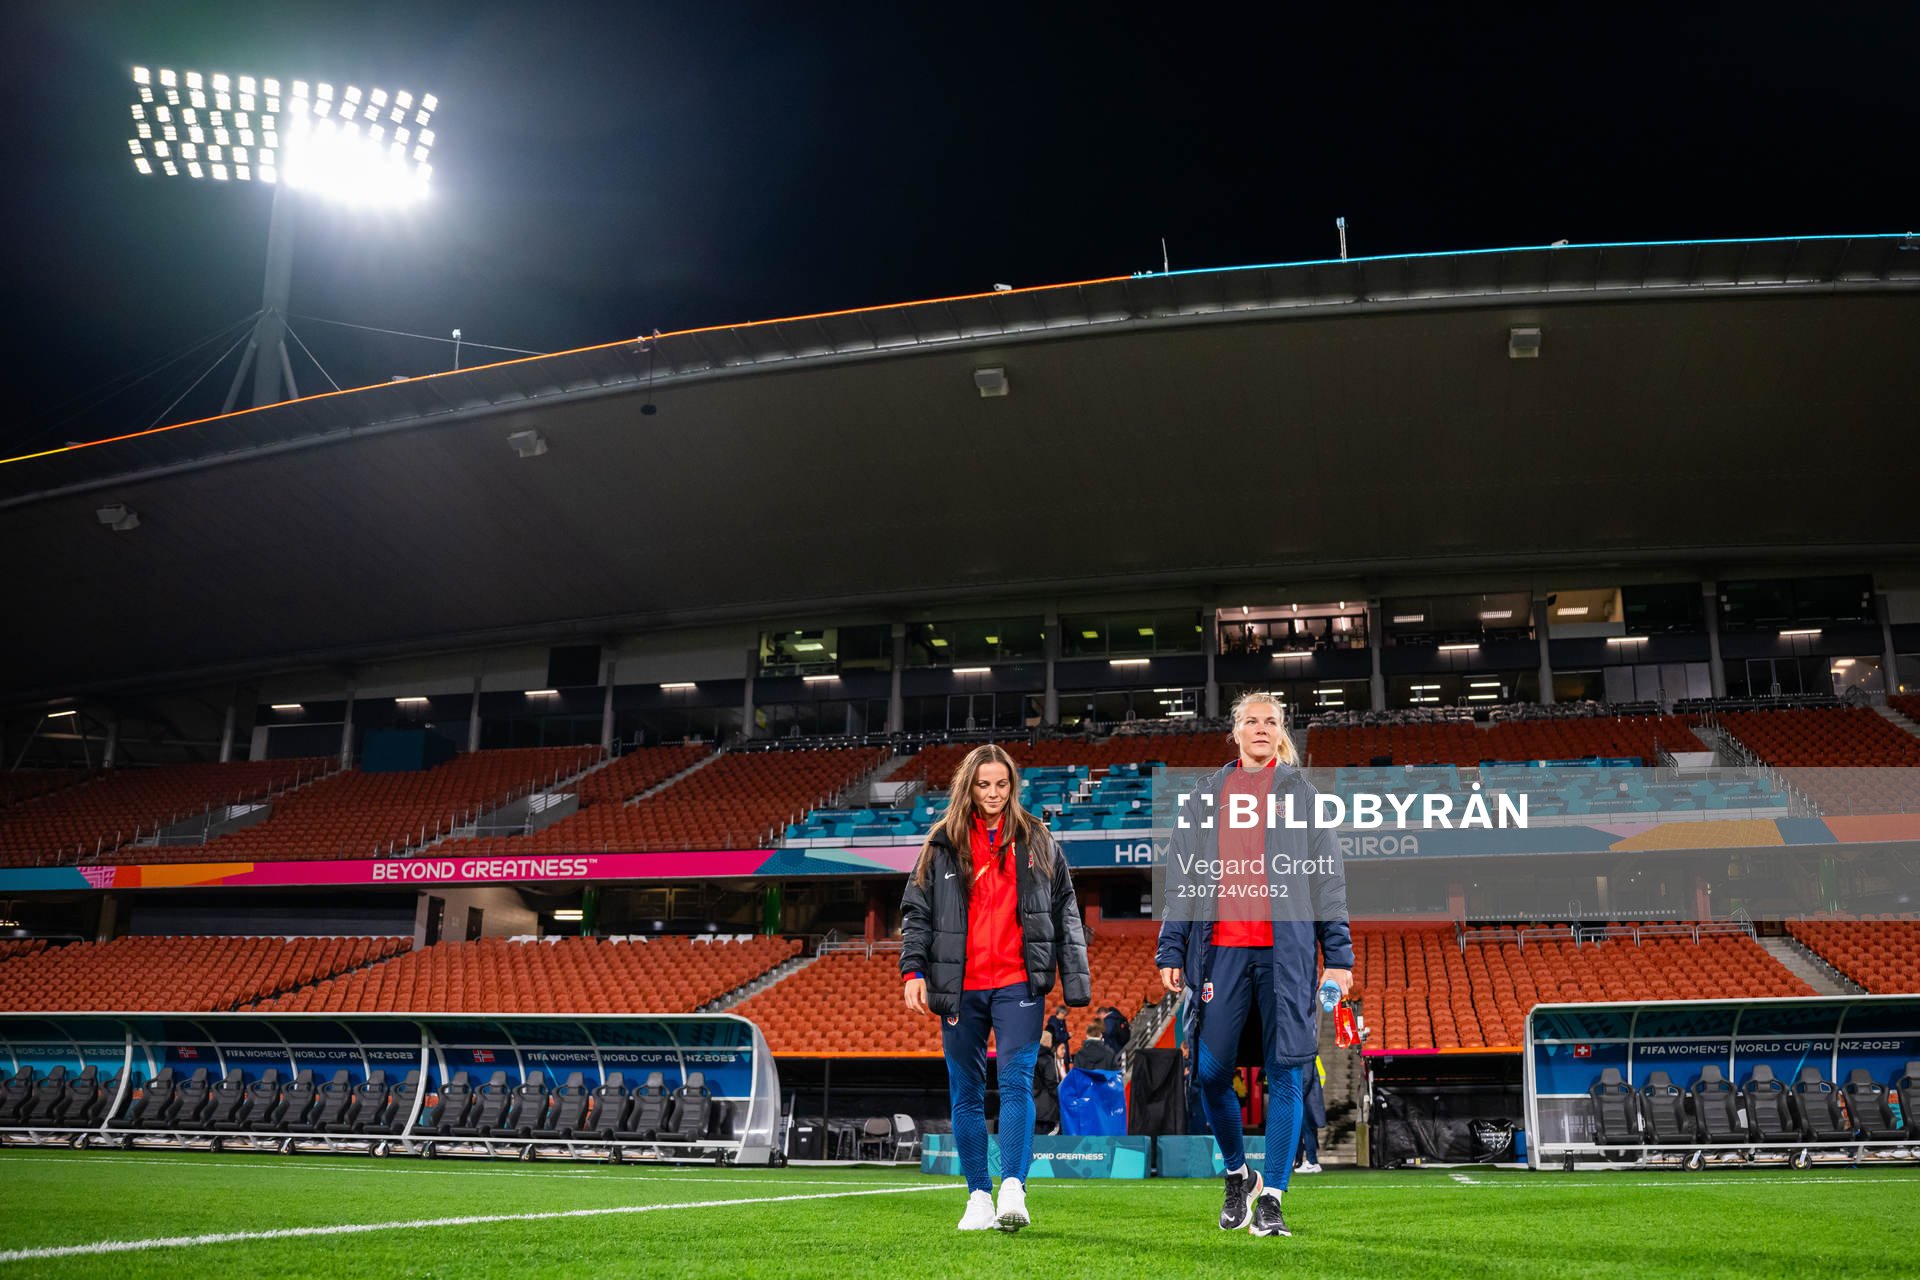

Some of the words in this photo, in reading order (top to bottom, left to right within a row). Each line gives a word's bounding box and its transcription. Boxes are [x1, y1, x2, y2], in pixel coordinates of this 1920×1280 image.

[372, 861, 456, 880] BEYOND
[1639, 1046, 1666, 1055] FIFA
[1668, 1044, 1728, 1054] WOMEN'S
[1735, 1043, 1780, 1053] WORLD
[1783, 1042, 1811, 1052] CUP
[245, 1050, 289, 1058] WOMEN'S
[328, 1051, 347, 1059] CUP
[527, 1053, 549, 1061] FIFA
[549, 1053, 598, 1062] WOMEN'S
[602, 1054, 639, 1062] WORLD
[641, 1054, 663, 1062] CUP
[1032, 1152, 1055, 1160] YOND
